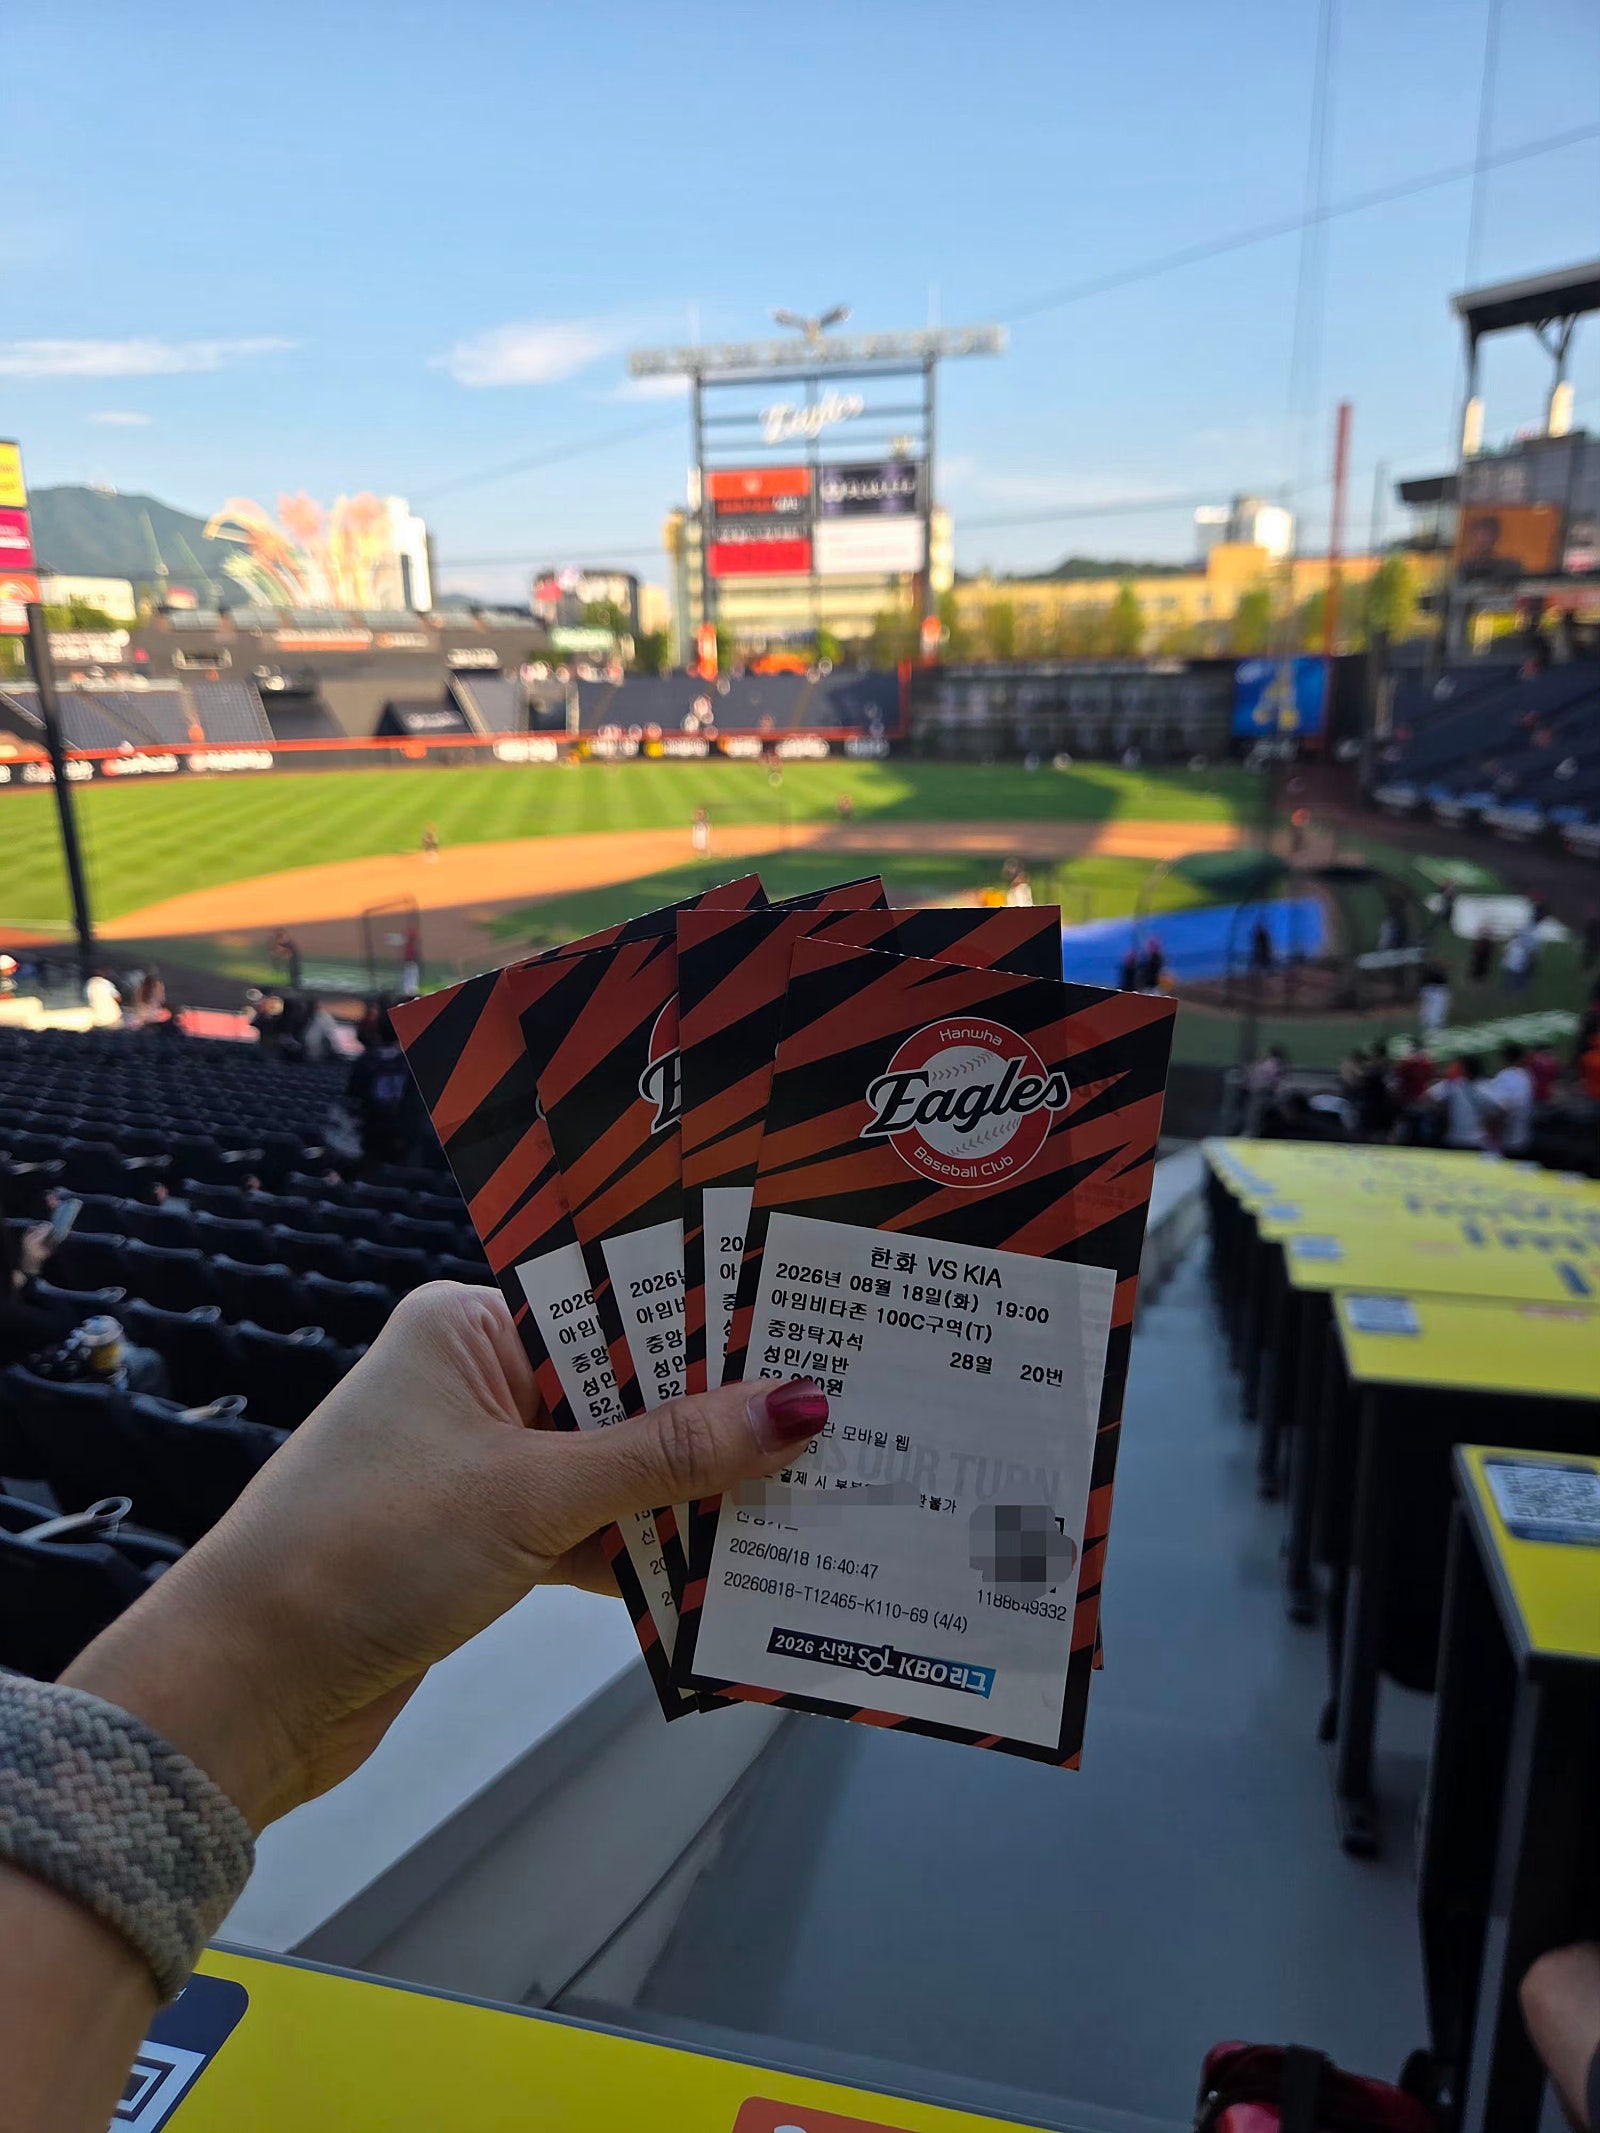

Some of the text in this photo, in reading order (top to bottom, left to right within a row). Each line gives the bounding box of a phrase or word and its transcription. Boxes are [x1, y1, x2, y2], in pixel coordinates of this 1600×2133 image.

[939, 1028, 1003, 1046] Hanwha
[858, 1056, 1071, 1138] Eagles
[913, 1146, 1014, 1178] Baseball Club
[870, 1246, 1002, 1288] 한화 VS KIA
[775, 1262, 1050, 1324] 2026년 08월 18일(화) 19:00
[767, 1319, 865, 1351] 중앙탁자석
[770, 1289, 993, 1344] 아임비타존 100C구역(T)
[763, 1346, 1064, 1388] 성인/일반 28열 20번
[842, 1425, 888, 1448] 모바일
[896, 1434, 910, 1452] 웹
[814, 1474, 827, 1490] 시
[729, 1538, 878, 1579] 2026/08/18 16:40:47
[724, 1571, 968, 1634] 20260818-T12465-K110-69 (4/4)
[774, 1634, 814, 1655] 2026
